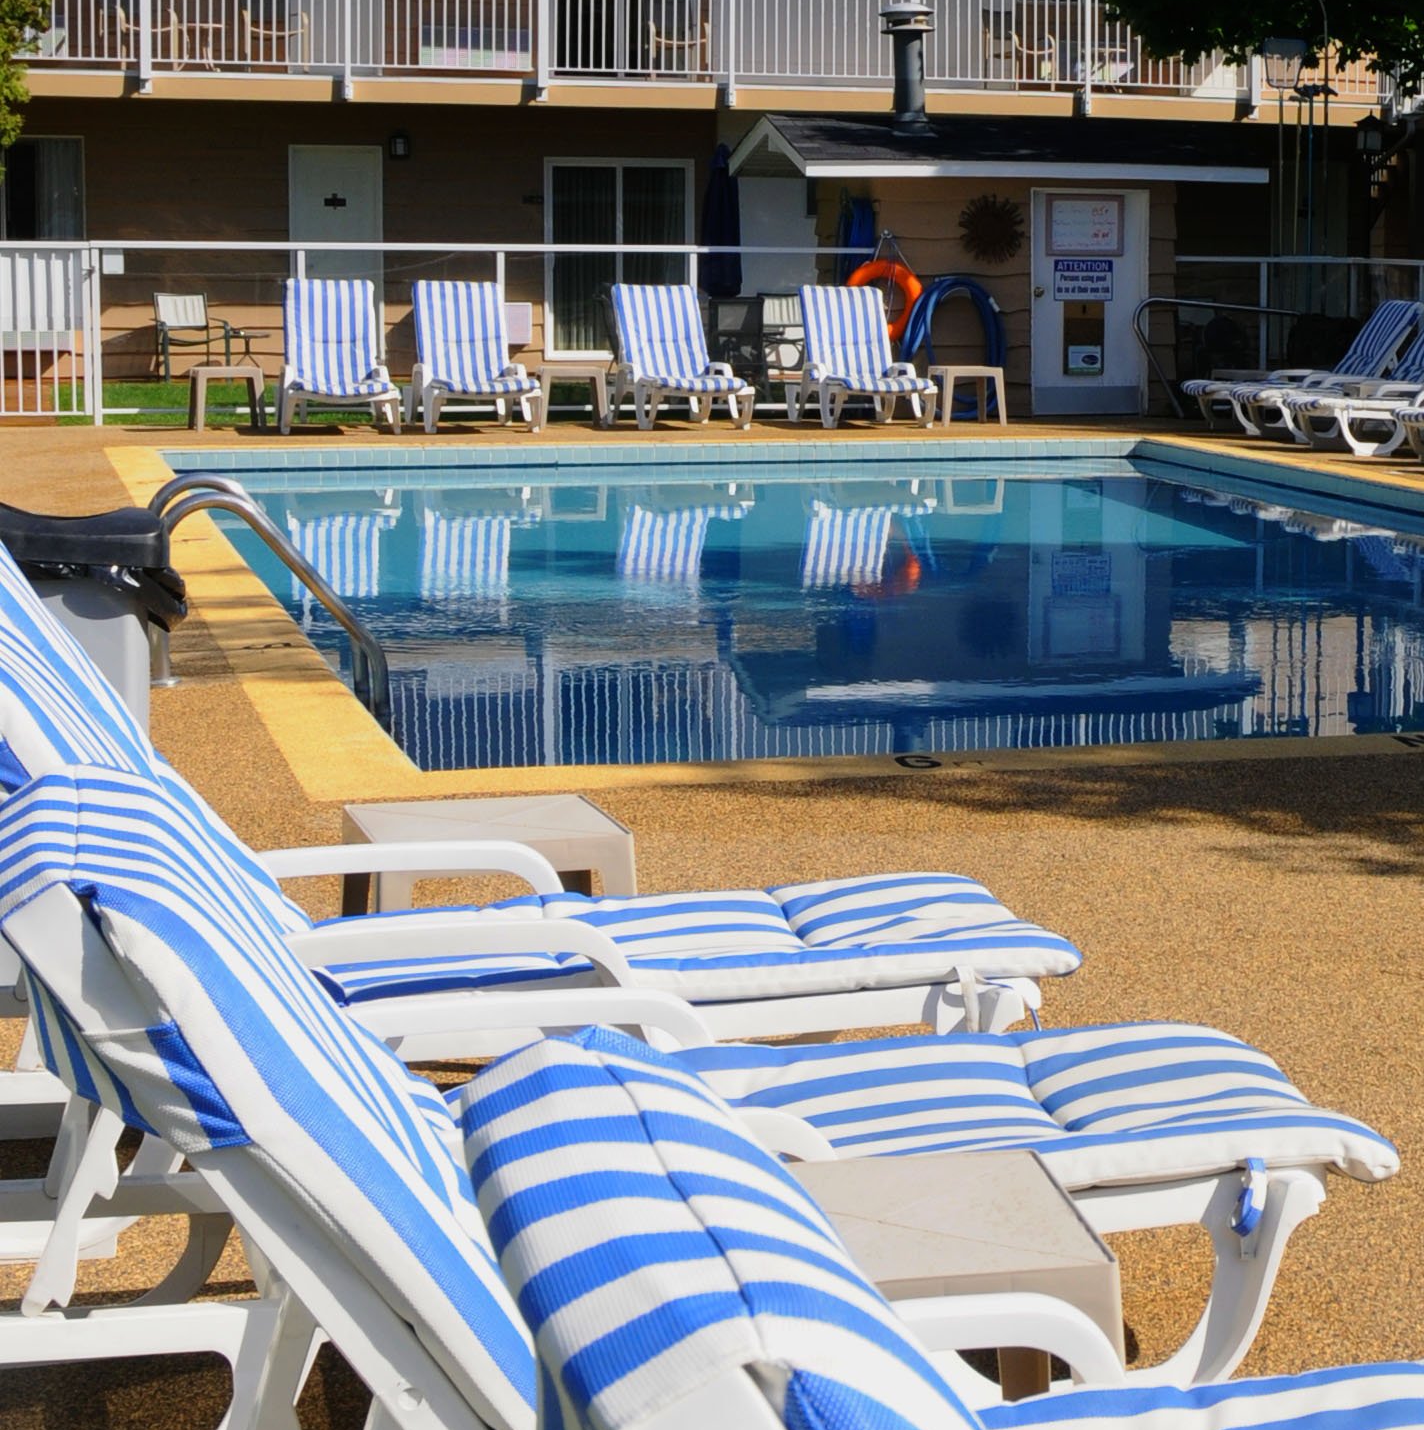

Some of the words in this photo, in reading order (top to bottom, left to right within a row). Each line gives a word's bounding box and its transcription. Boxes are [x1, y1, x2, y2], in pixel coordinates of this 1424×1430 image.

[1057, 261, 1109, 271] ATTENTION
[1060, 273, 1080, 282] Persons
[1081, 274, 1094, 283] using
[1095, 274, 1107, 283] pool
[1057, 285, 1063, 293] do
[1071, 285, 1076, 293] at
[1077, 285, 1089, 293] their
[1101, 285, 1110, 293] risk
